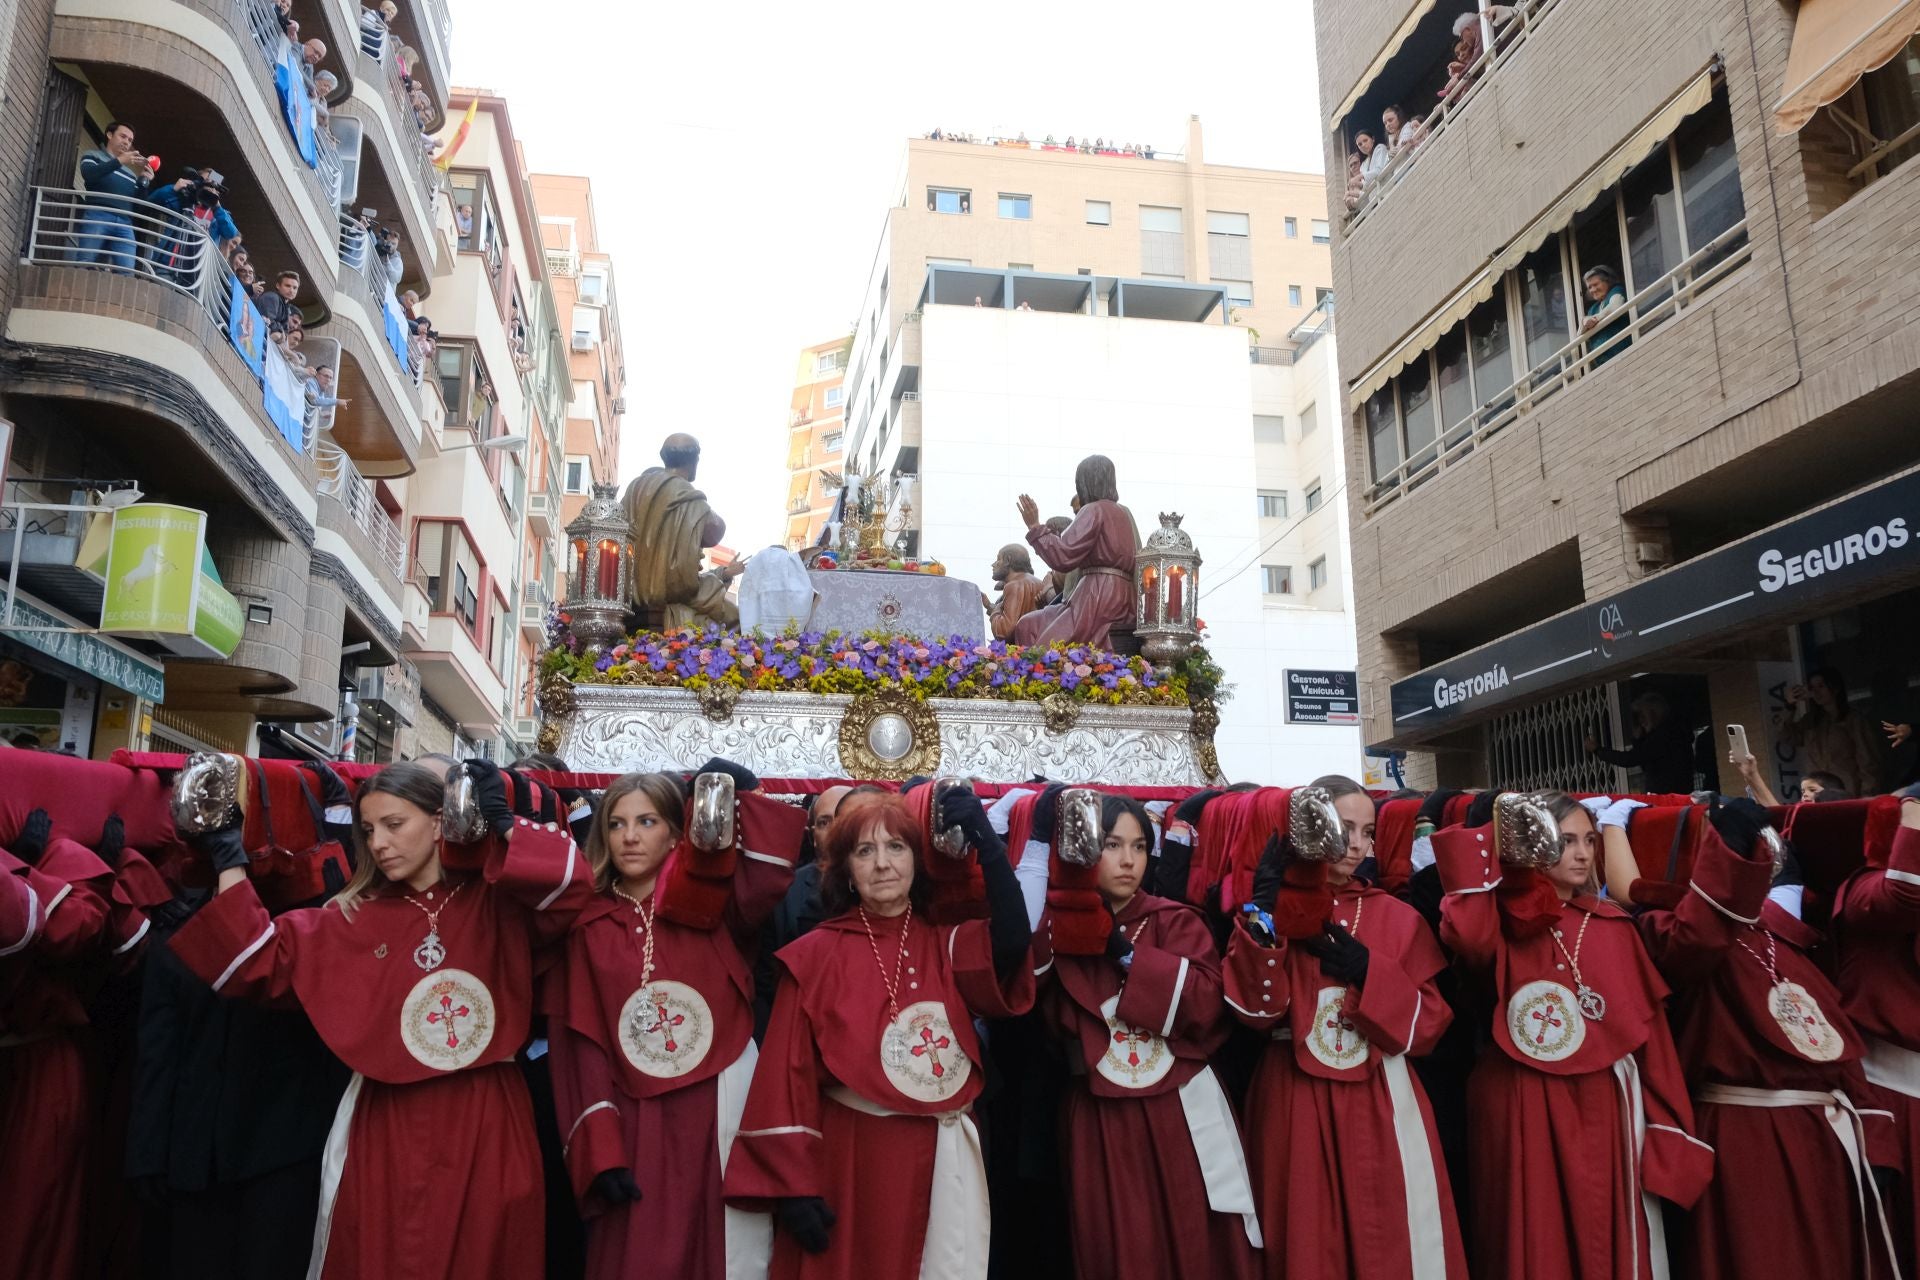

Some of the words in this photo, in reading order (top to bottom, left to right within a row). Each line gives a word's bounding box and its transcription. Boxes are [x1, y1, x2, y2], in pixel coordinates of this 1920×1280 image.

[116, 516, 197, 532] RESTAURANTE
[1758, 517, 1909, 593] SEGUROS
[1291, 673, 1330, 685] GESTORÍA
[1301, 684, 1345, 696] VEHÍCULOS
[1433, 663, 1509, 709] GESTORÍA
[1294, 701, 1322, 710] SEGUROS
[1294, 712, 1327, 721] ABOGADOS
